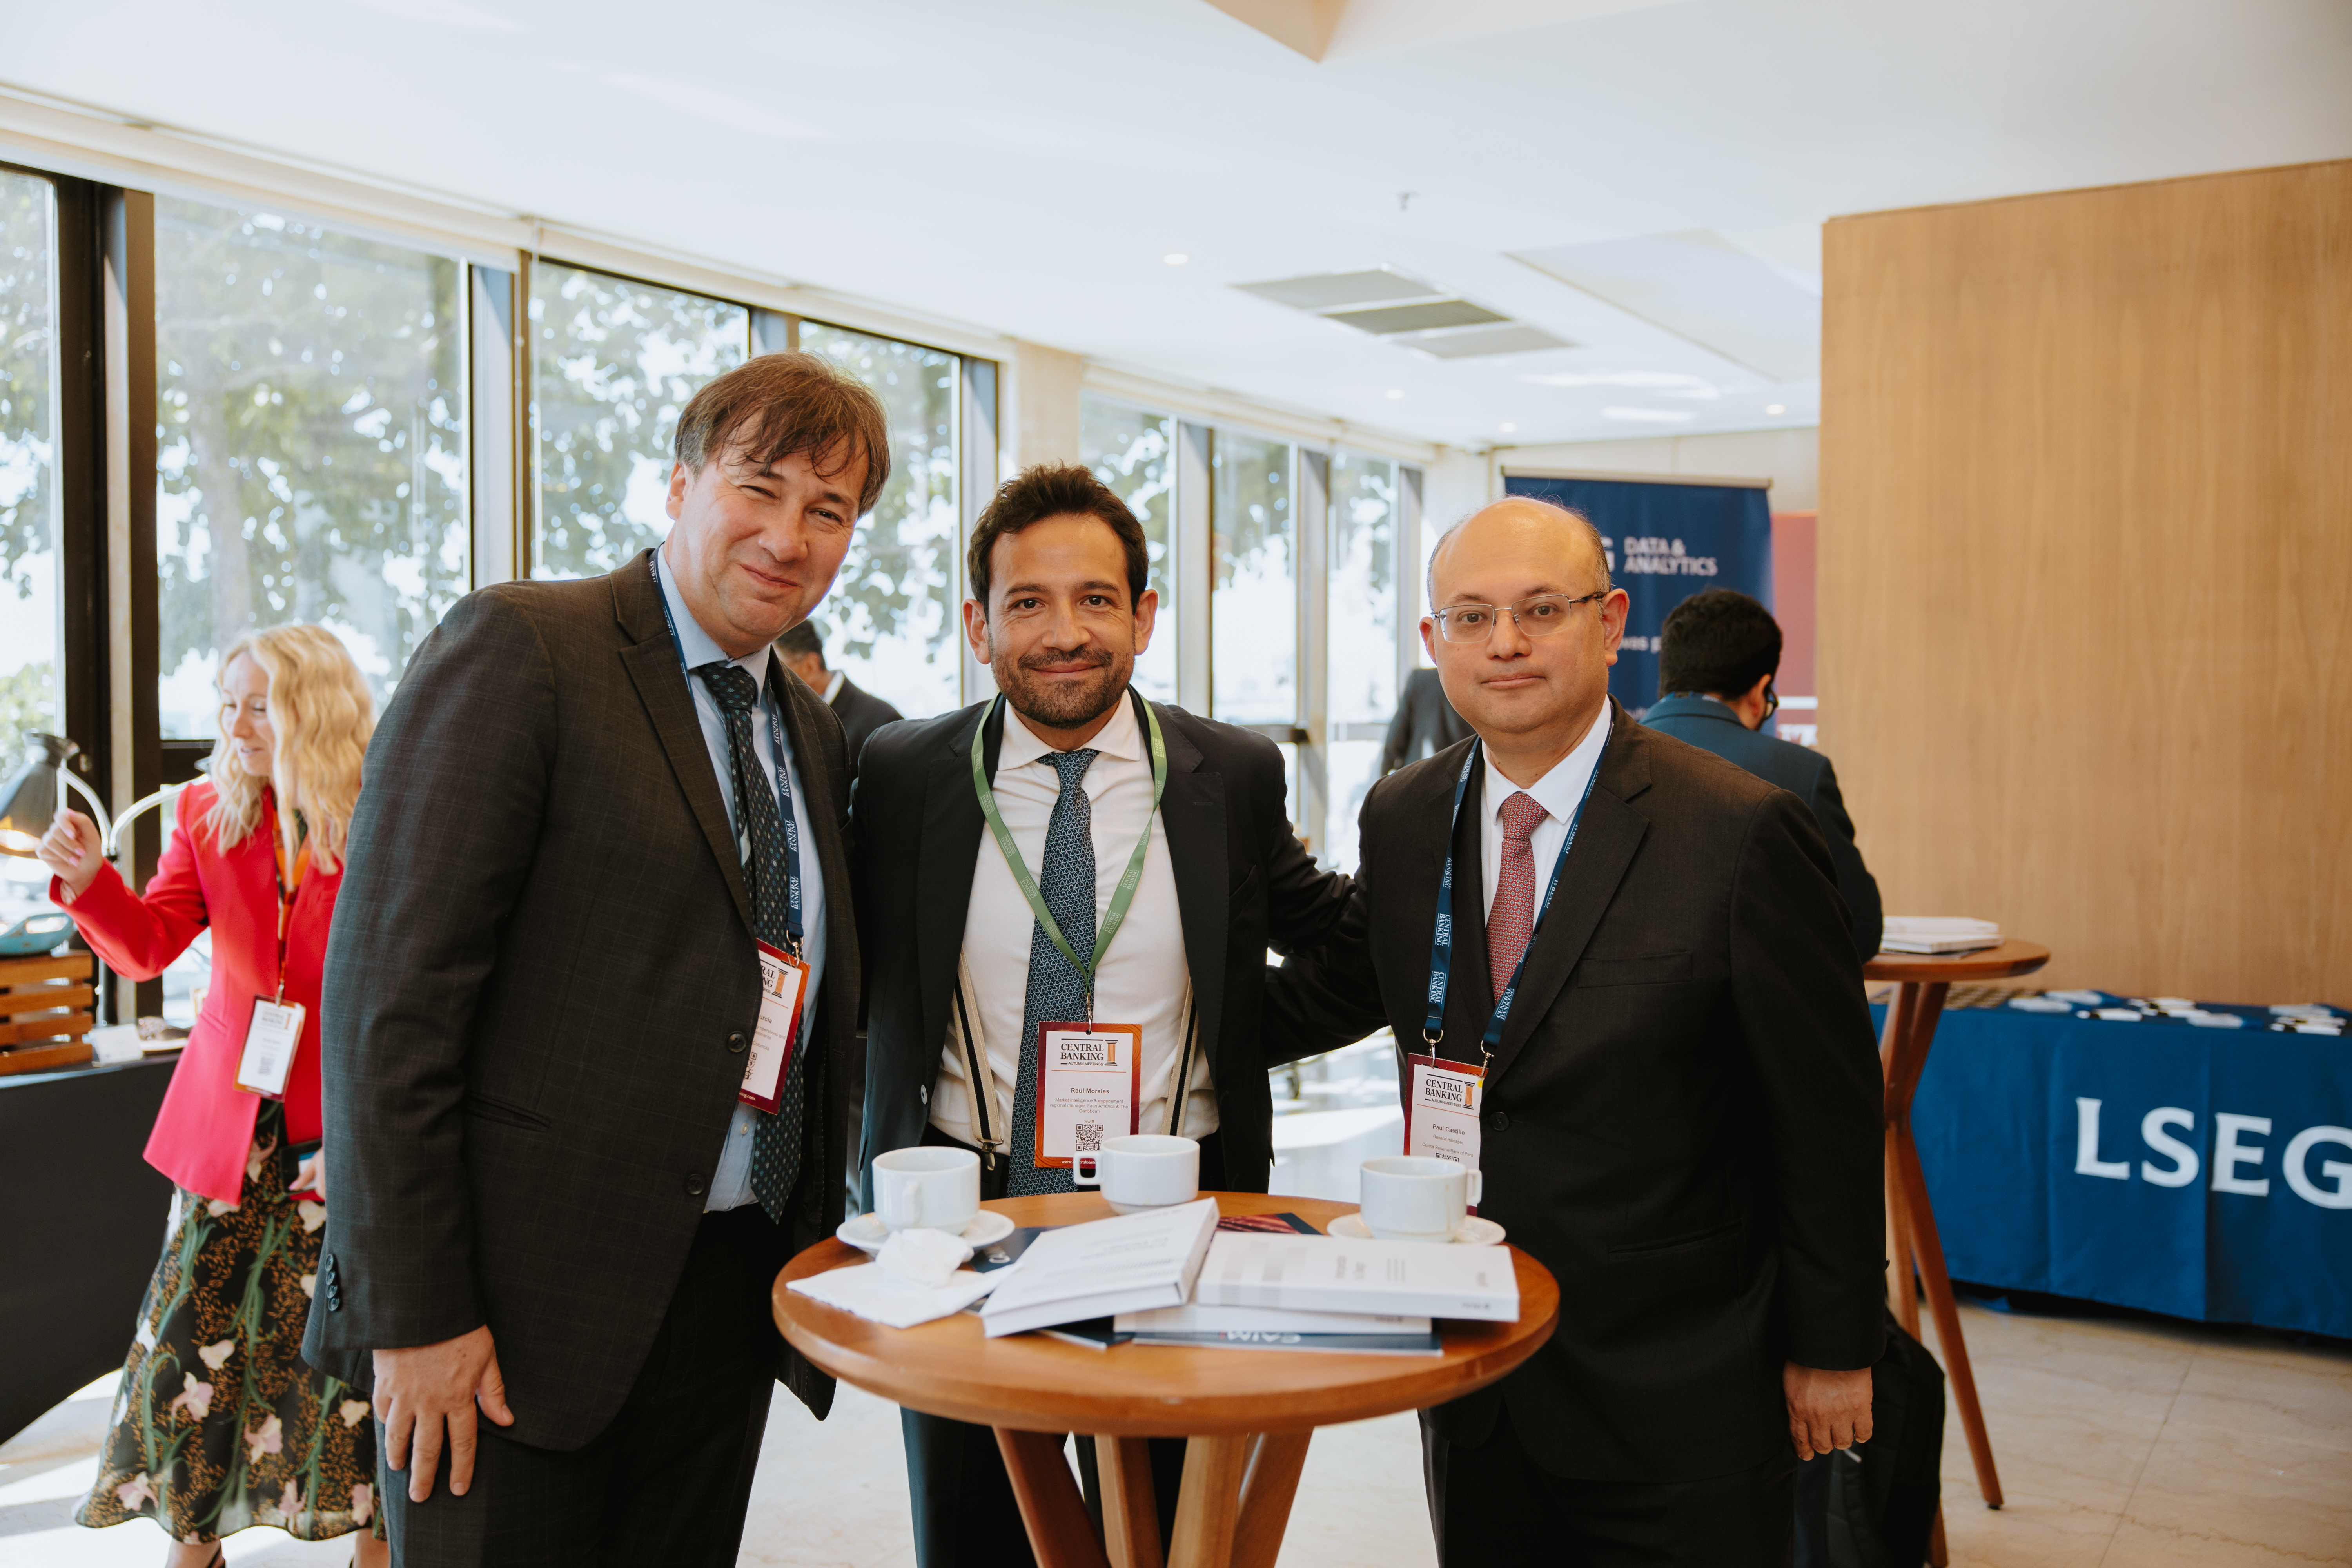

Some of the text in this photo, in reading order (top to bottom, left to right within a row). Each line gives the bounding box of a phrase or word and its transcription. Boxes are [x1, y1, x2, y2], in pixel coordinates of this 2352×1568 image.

[1624, 537, 1670, 554] DATA
[1624, 556, 1718, 576] ANALYTICS
[1123, 869, 1134, 887] CENTRAL
[1127, 870, 1137, 889] BANKING
[1105, 912, 1116, 931] CENTRAL
[1108, 913, 1120, 933] BANKING
[1436, 913, 1445, 946] BANKING
[1442, 915, 1450, 946] CENTRAL
[1430, 971, 1439, 1003] BANKING
[1435, 972, 1445, 1003] CENTRAL
[1496, 987, 1511, 1018] CENTRAL
[1500, 988, 1514, 1020] BANKING
[759, 1015, 772, 1024] urcia
[753, 1041, 769, 1051] Colombia
[1061, 1043, 1104, 1051] CENTRAL
[1060, 1052, 1104, 1060] BANKING
[1425, 1087, 1462, 1102] BANKING
[1426, 1079, 1463, 1093] CENTRAL
[1445, 1127, 1465, 1135] Castillo
[2075, 1097, 2352, 1209] LSEG
